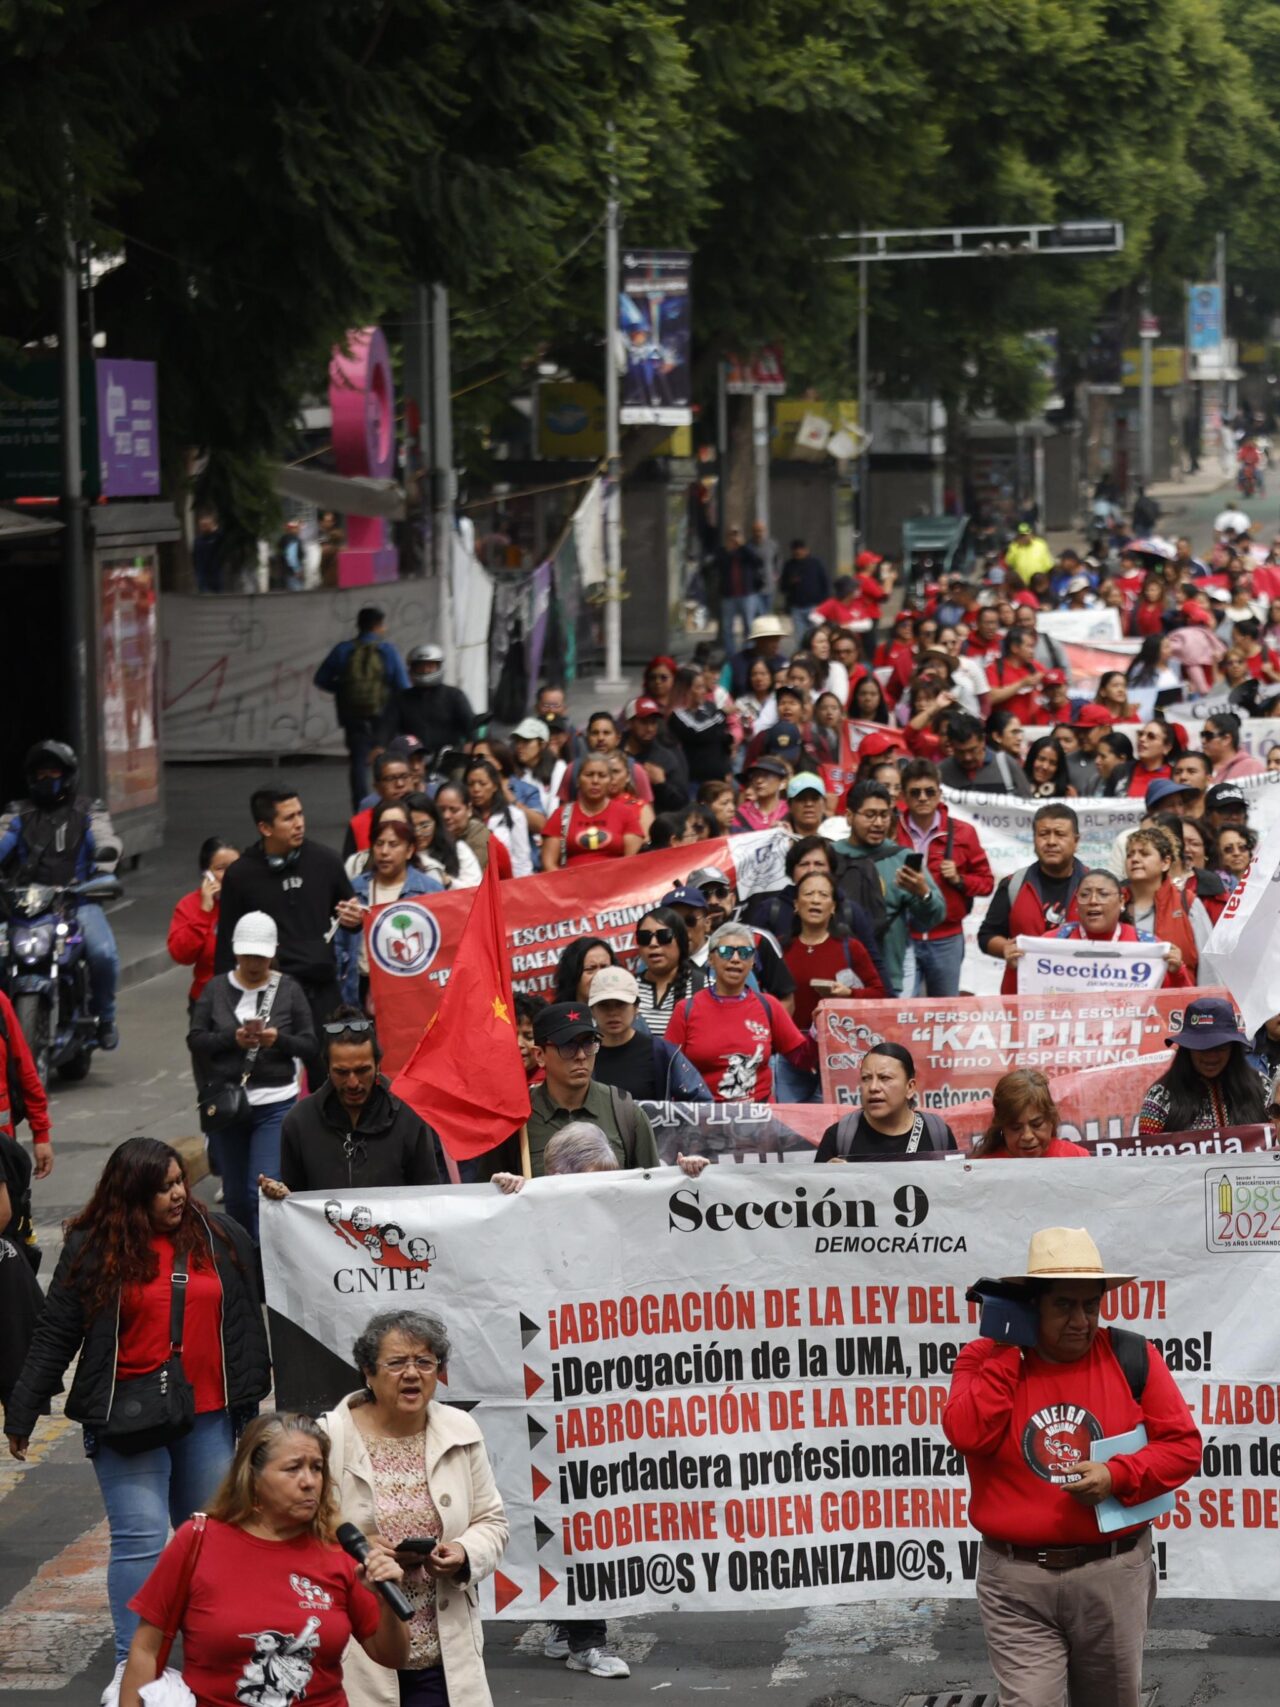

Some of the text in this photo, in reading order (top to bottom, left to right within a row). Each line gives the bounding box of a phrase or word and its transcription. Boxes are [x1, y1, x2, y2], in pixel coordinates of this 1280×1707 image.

[1085, 812, 1105, 828] AL
[512, 900, 664, 948] ESCUELA PRIMA
[1036, 958, 1152, 983] Sección 9
[897, 1005, 1159, 1025] EL PERSONAL DE LA ESCUELA
[827, 1055, 864, 1070] CNT
[927, 1048, 1140, 1069] Turno VESPERTINO
[646, 1102, 773, 1126] CNTE
[1096, 1134, 1243, 1158] Primaria
[668, 1184, 930, 1234] Sección 9
[814, 1232, 968, 1254] DEMOCRÁTICA
[332, 1266, 426, 1295] CNTE
[548, 1284, 757, 1351] ¡ABROGACIÓN
[764, 1287, 801, 1329] DE
[808, 1286, 845, 1327] LA
[851, 1286, 900, 1325] LEY
[908, 1285, 961, 1325] DEL
[1100, 1281, 1167, 1321] 007!
[552, 1341, 744, 1402] ¡Derogación
[751, 1340, 791, 1380] de
[800, 1338, 828, 1378] la
[835, 1336, 912, 1379] UMA,
[555, 1386, 762, 1454] ¡ABROGACIÓN
[768, 1390, 806, 1430] DE
[812, 1388, 848, 1428] LA
[856, 1385, 948, 1426] REFOR
[1030, 1404, 1087, 1430] HUELGA
[558, 1448, 732, 1505] ¡Verdadera
[740, 1438, 965, 1491] profesionaliza
[562, 1501, 718, 1555] ¡GOBIERNE
[724, 1494, 814, 1544] QUIEN
[820, 1488, 968, 1533] GOBIERNE
[1200, 1489, 1235, 1529] SE
[566, 1552, 695, 1605] ¡UNID@S
[701, 1552, 720, 1593] Y
[728, 1538, 953, 1591] ORGANIZAD@S,
